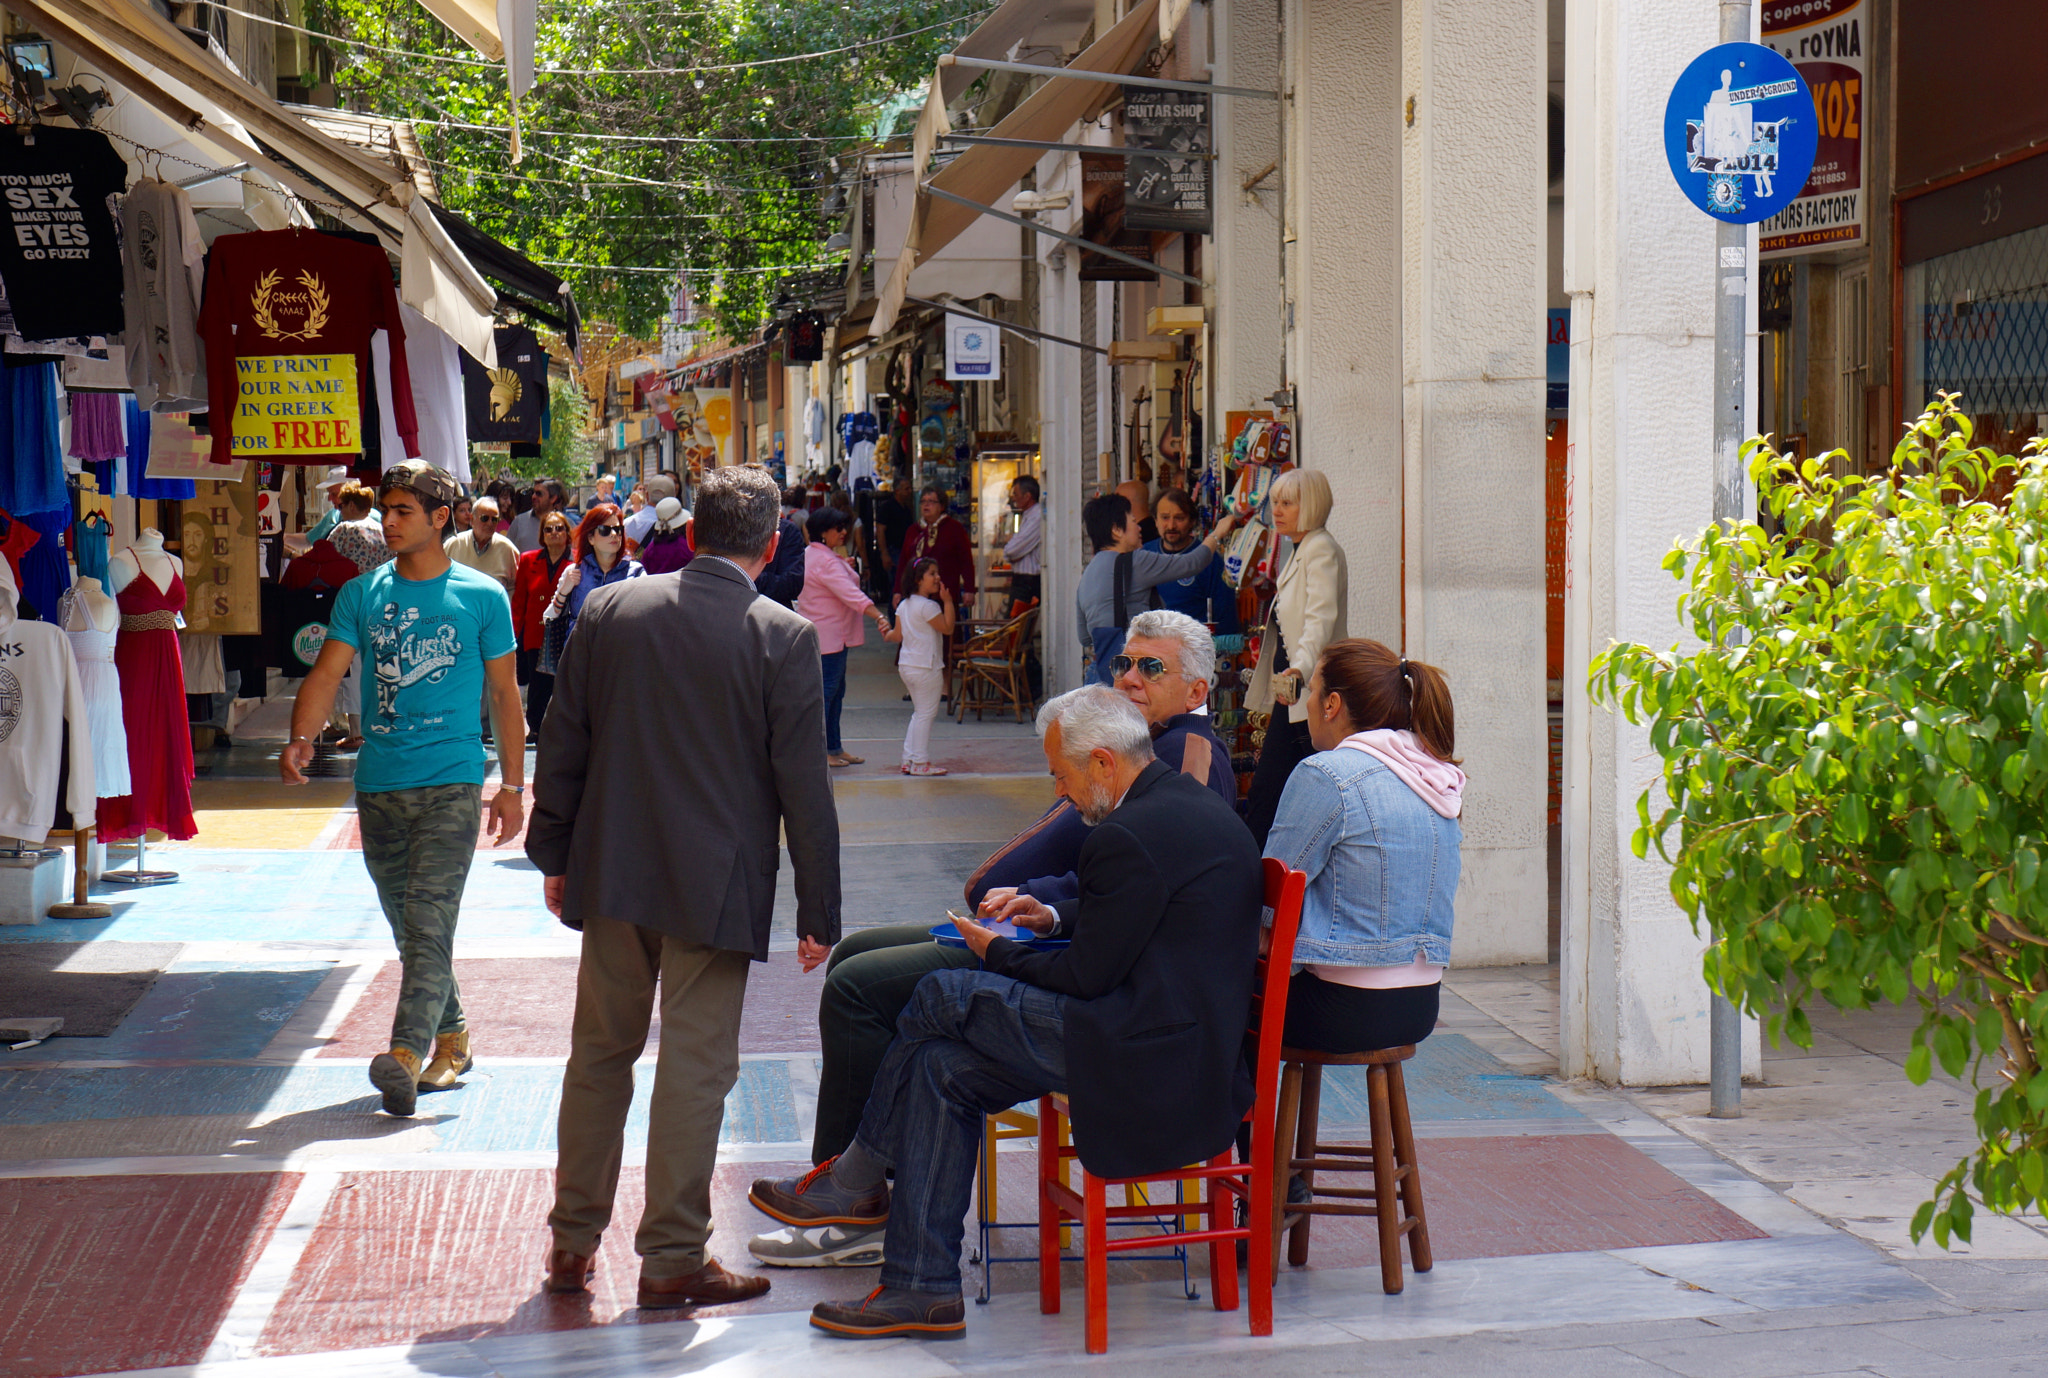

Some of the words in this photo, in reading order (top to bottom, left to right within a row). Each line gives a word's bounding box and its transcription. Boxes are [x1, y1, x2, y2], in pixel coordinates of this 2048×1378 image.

[1800, 19, 1861, 58] ΓΟΥΝΑ
[1729, 89, 1756, 102] UNDER
[1767, 81, 1796, 95] GROUND
[1127, 104, 1171, 118] GUITAR
[1173, 104, 1204, 123] SHOP
[1828, 161, 1838, 171] 33
[0, 176, 28, 186] TOO
[30, 173, 72, 186] MUCH
[1171, 173, 1205, 182] GUITARS
[1811, 171, 1847, 186] 3218853
[1174, 183, 1206, 191] PEDALS
[5, 186, 80, 209] SEX
[1181, 192, 1206, 201] AMPS
[1981, 184, 2001, 225] 33
[1174, 201, 1181, 210] &
[1182, 201, 1206, 210] MORE
[1806, 194, 1857, 226] FACTORY
[11, 211, 51, 222] MAKES
[51, 211, 83, 221] YOUR
[14, 224, 90, 246] EYES
[1798, 228, 1855, 244] Λιανική
[24, 249, 46, 260] GO
[48, 249, 90, 259] FUZZY
[272, 292, 309, 305] GREECE
[237, 359, 267, 374] WE
[273, 358, 332, 373] PRINT
[240, 381, 282, 395] OUR
[288, 379, 345, 394] NAME
[241, 403, 261, 416] IN
[267, 400, 334, 416] GREEK
[232, 435, 269, 449] FOR
[272, 419, 352, 449] FREE
[421, 616, 439, 625] FOOT
[441, 614, 458, 622] BALL
